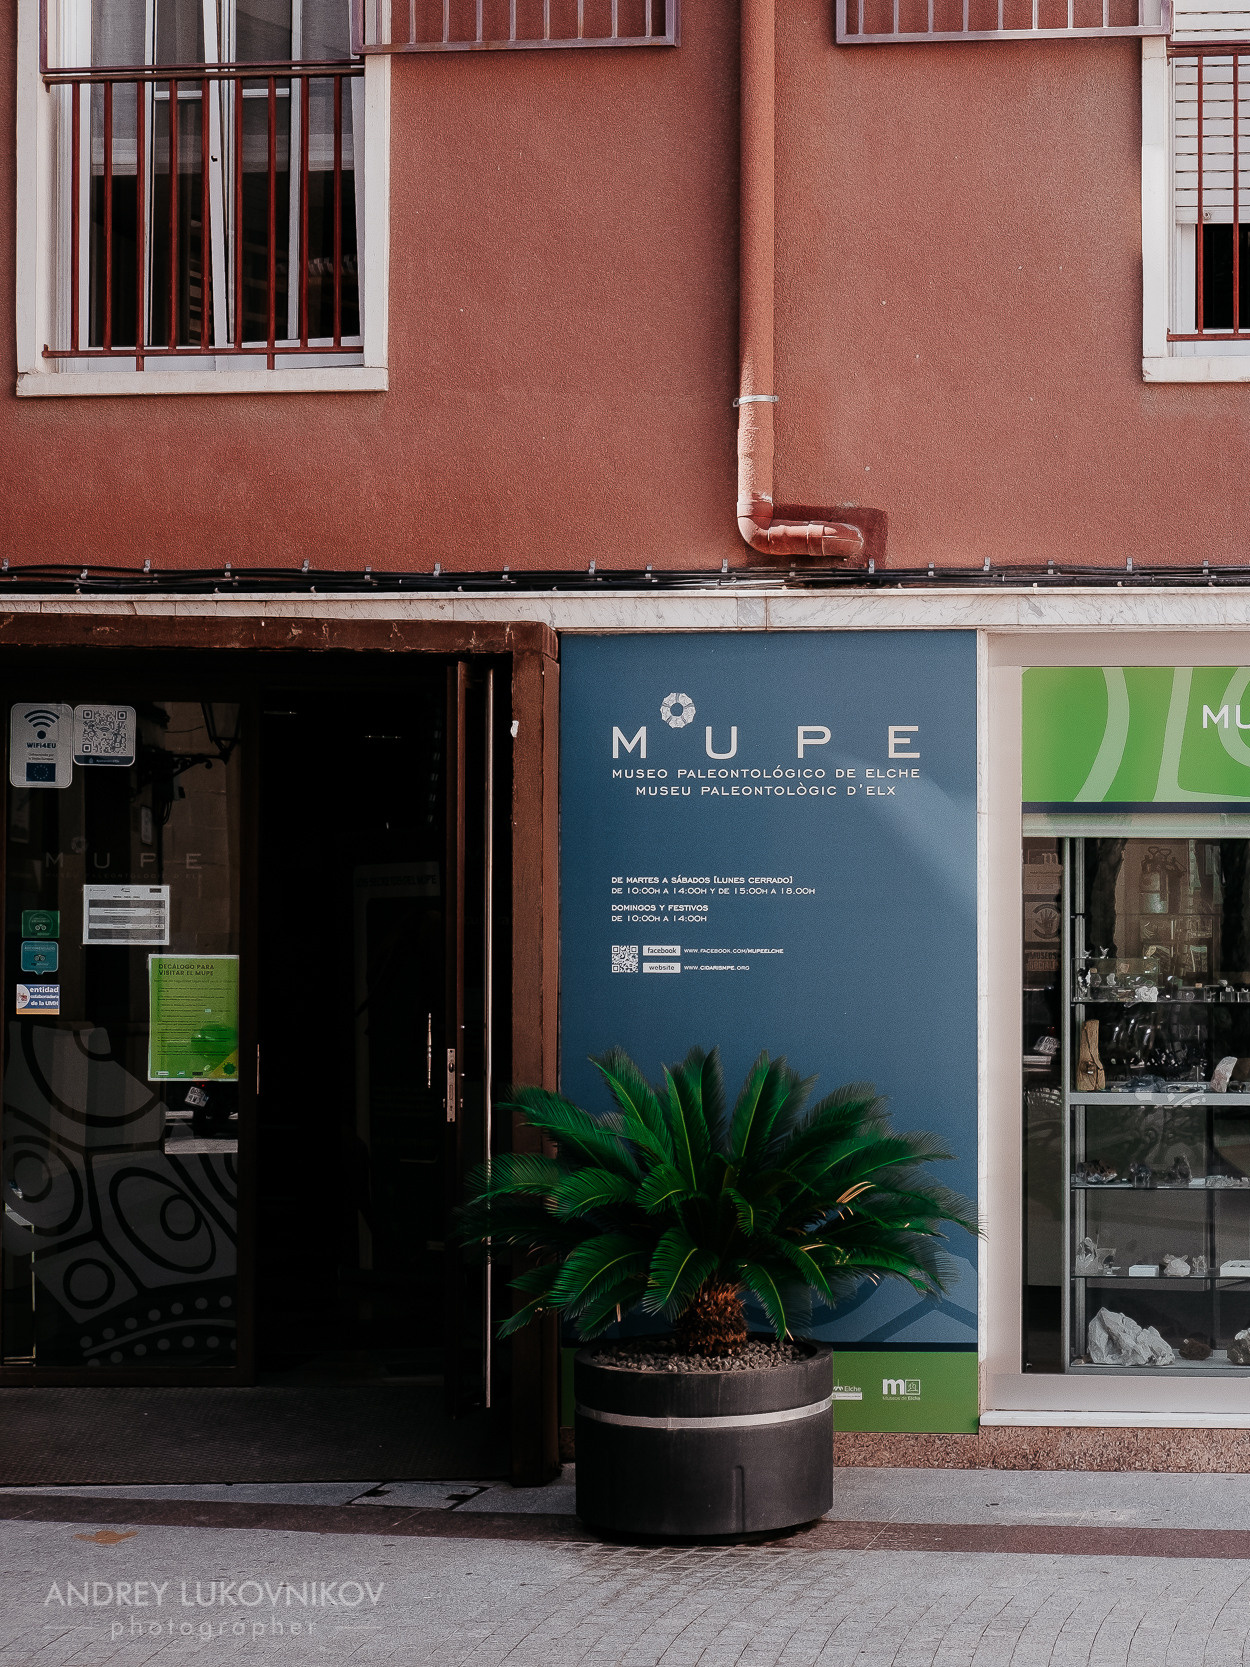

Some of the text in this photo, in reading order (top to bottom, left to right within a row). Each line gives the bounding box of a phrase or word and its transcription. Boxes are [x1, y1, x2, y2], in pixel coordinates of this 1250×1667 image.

[613, 726, 920, 759] MUPE
[613, 765, 919, 778] MUSEO PALEONTOLÓGICO DE ELCHE
[637, 782, 895, 795] MUSEU PALEONTOLÒGIC D'ELX
[46, 852, 202, 869] MUPE
[671, 875, 710, 883] SÁBADOS
